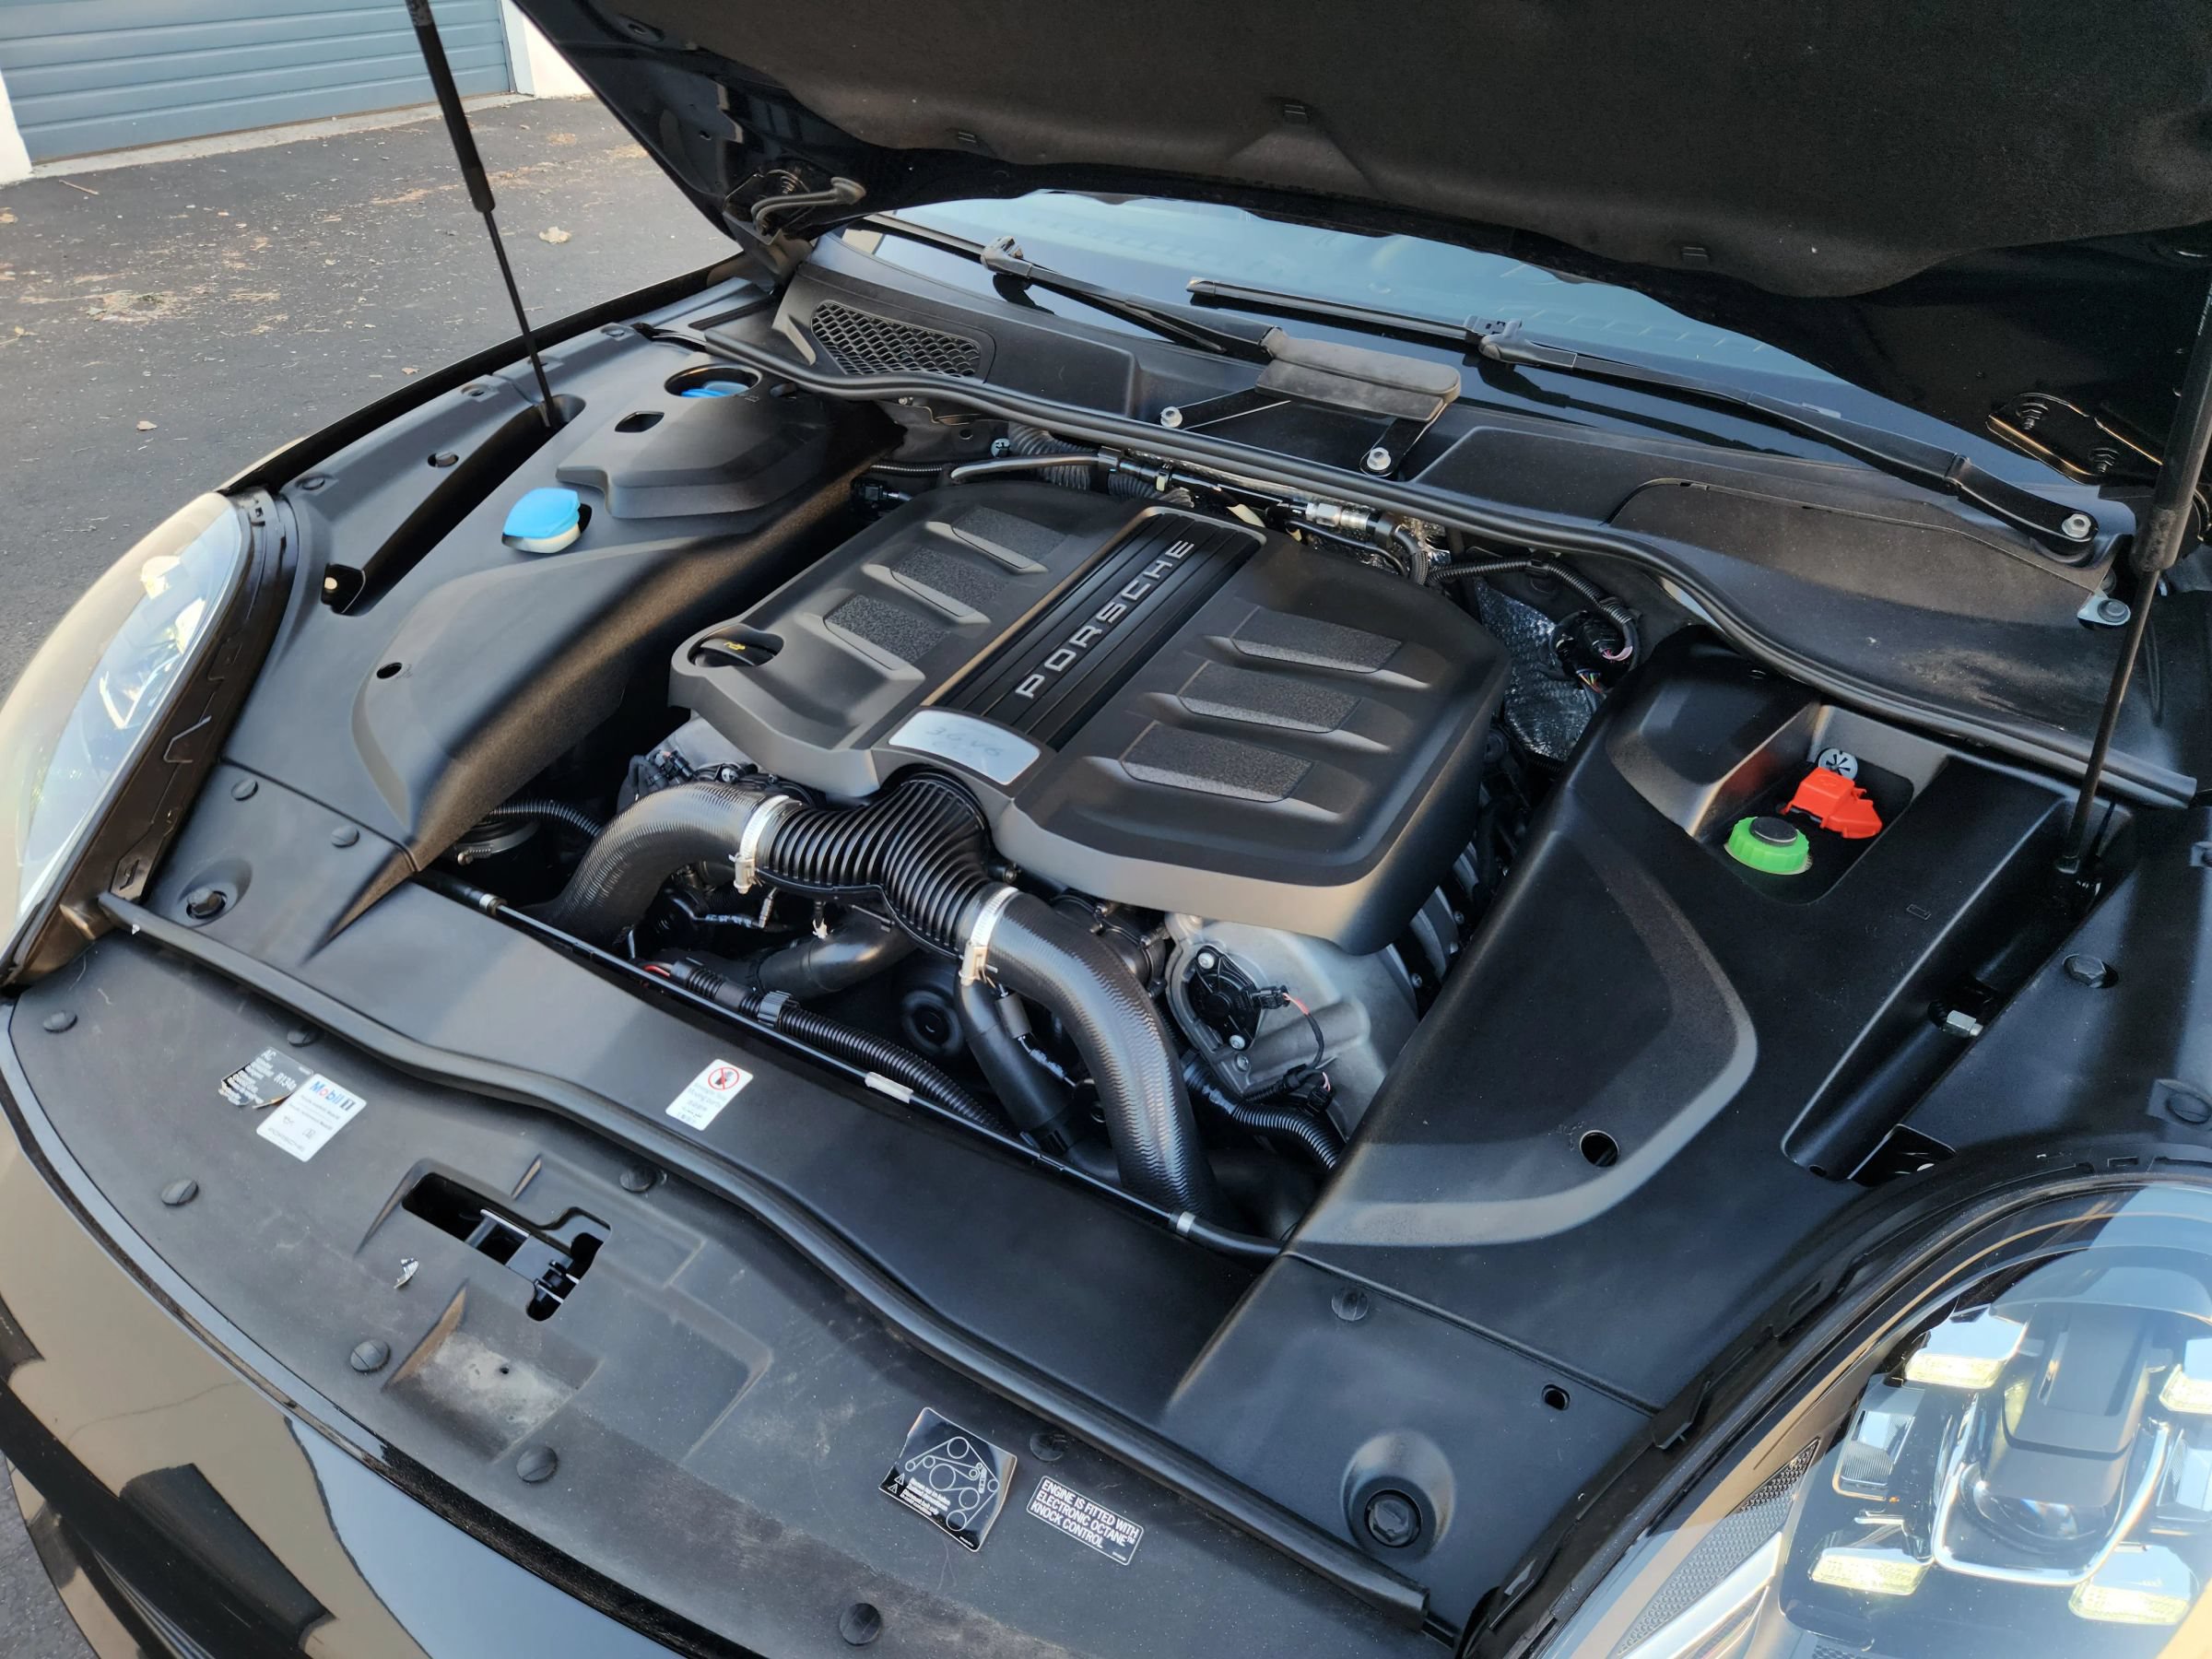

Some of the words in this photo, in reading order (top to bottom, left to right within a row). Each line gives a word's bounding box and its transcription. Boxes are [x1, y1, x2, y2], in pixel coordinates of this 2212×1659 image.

[1015, 540, 1194, 699] PORSCHE
[310, 1081, 345, 1104] Mobil
[1030, 1500, 1065, 1526] KNOCK
[1062, 1518, 1103, 1549] CONTROL
[1036, 1490, 1091, 1526] ELECTRONIC
[1041, 1478, 1076, 1505] ENGINE
[1074, 1497, 1086, 1510] IS
[1083, 1502, 1115, 1526] FITTED
[1115, 1518, 1139, 1538] WITH
